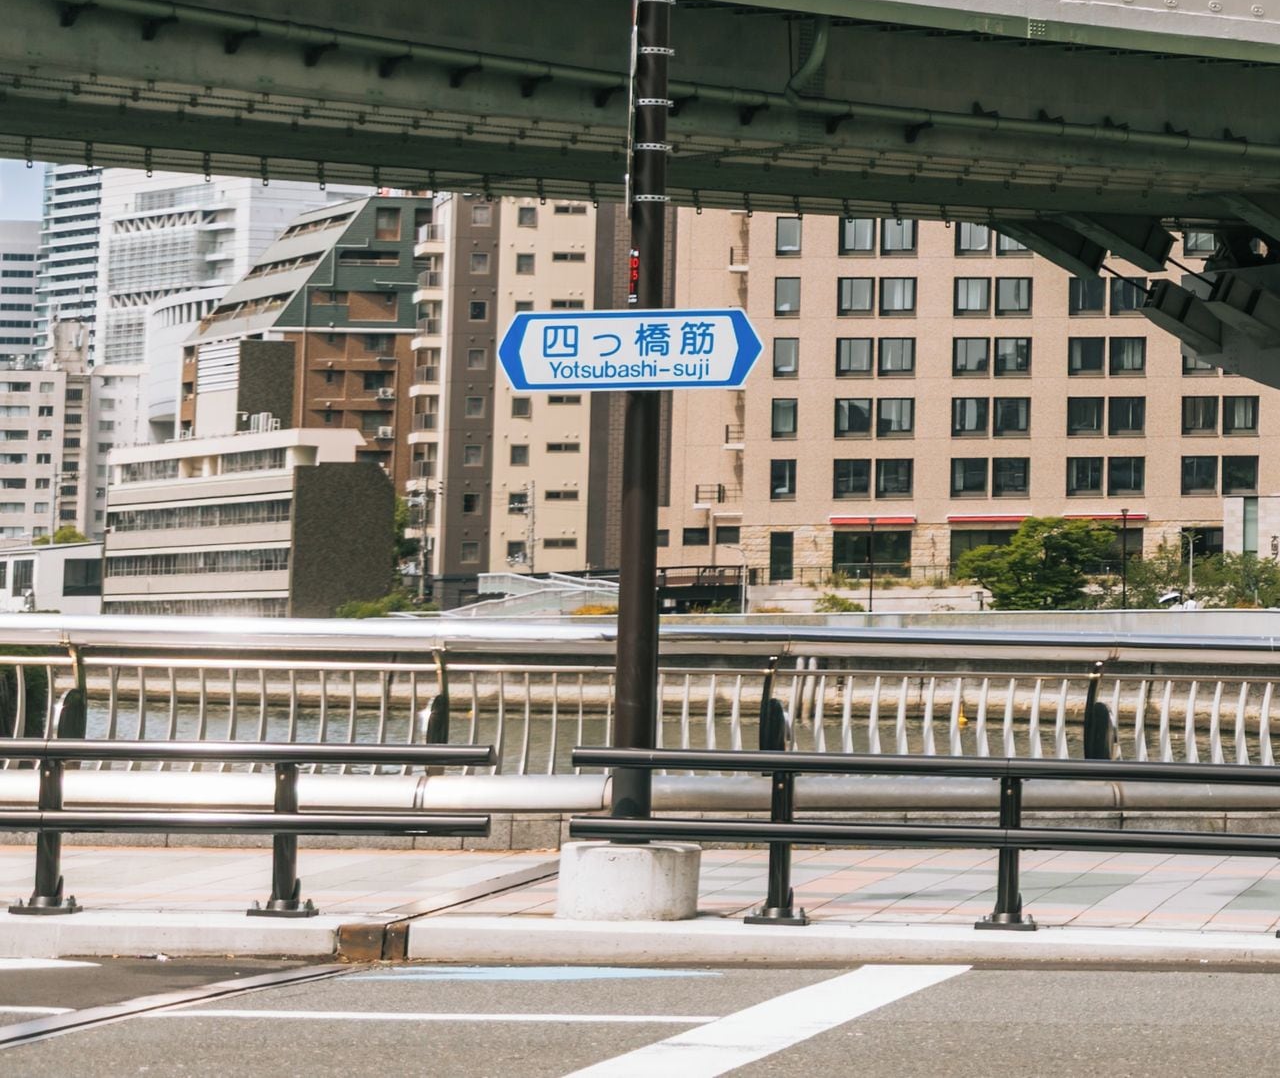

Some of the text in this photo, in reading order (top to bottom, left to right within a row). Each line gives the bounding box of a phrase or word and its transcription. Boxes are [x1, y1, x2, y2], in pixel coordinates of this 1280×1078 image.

[542, 321, 716, 358] 四つ橋筋
[549, 359, 710, 380] Yotsubashi-suji
